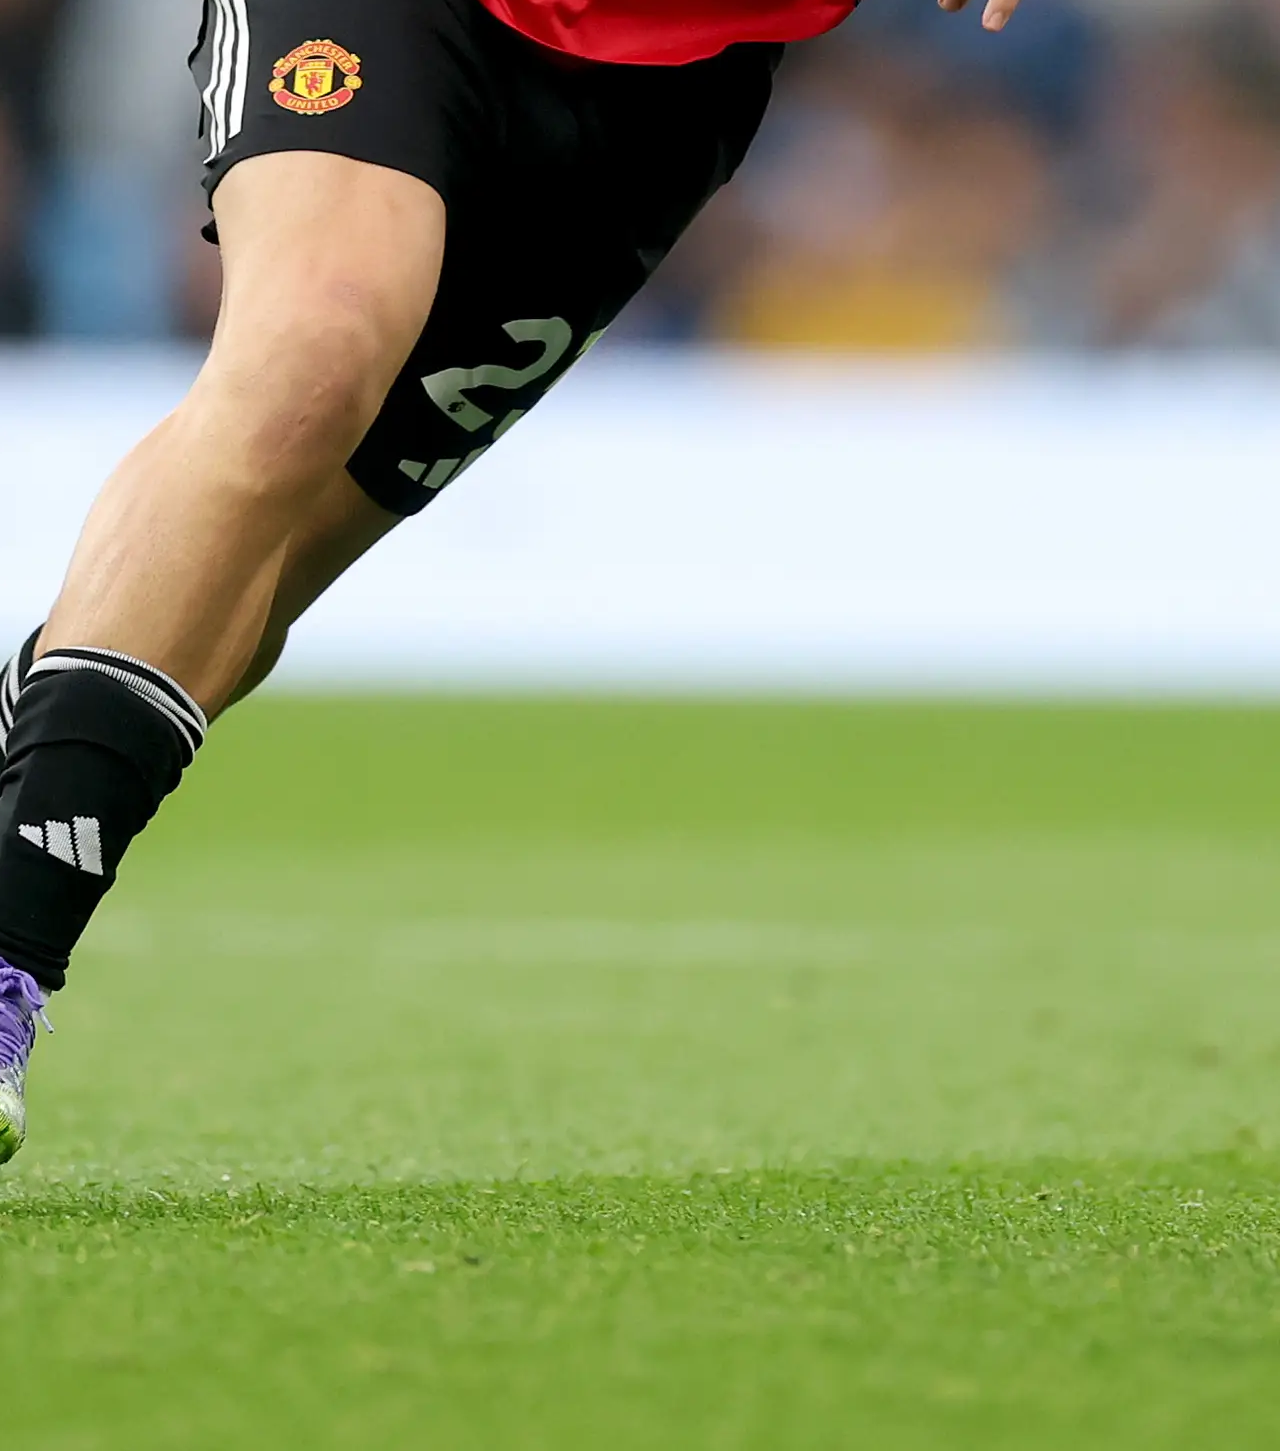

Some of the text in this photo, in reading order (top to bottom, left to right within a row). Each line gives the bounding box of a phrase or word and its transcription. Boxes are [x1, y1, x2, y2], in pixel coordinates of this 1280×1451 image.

[280, 45, 353, 71] MANCHESTER
[286, 98, 339, 110] UNITED
[421, 316, 606, 440] 2
